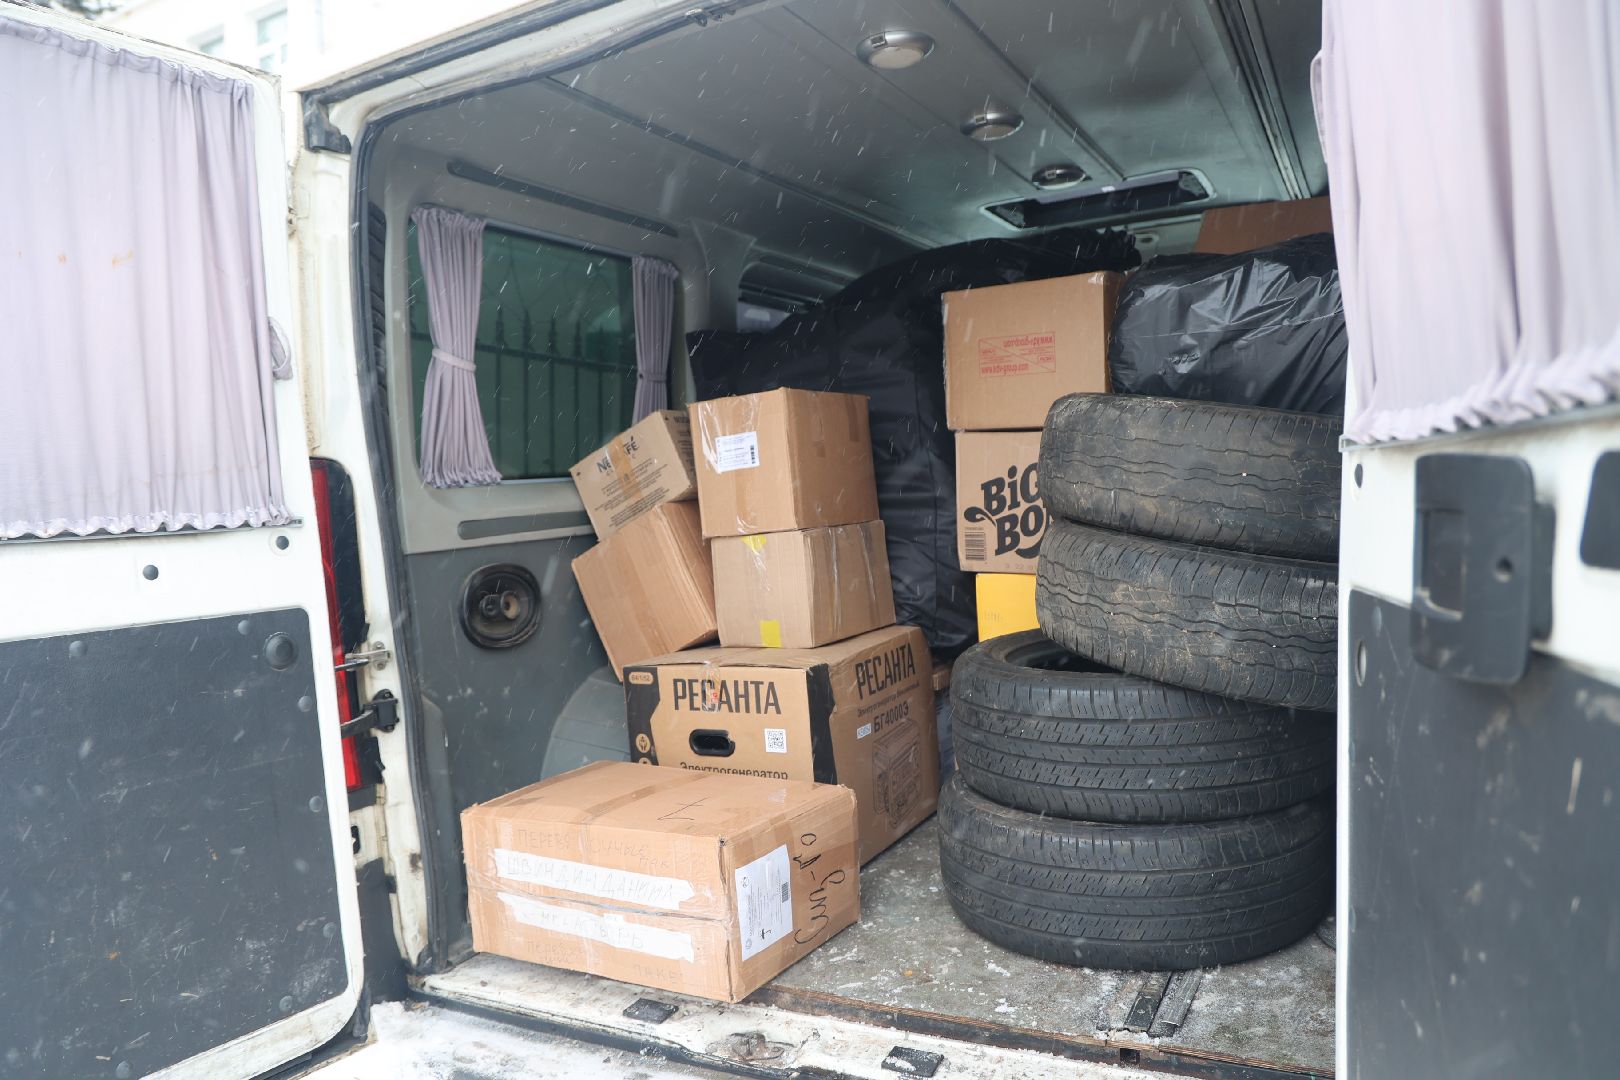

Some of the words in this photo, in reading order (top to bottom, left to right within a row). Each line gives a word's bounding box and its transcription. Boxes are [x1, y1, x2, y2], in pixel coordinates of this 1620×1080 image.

[995, 504, 1050, 557] BO
[855, 643, 915, 700] РЕСАНТА
[673, 678, 782, 714] РЕСАНТА
[873, 700, 909, 733] БГ4000Э
